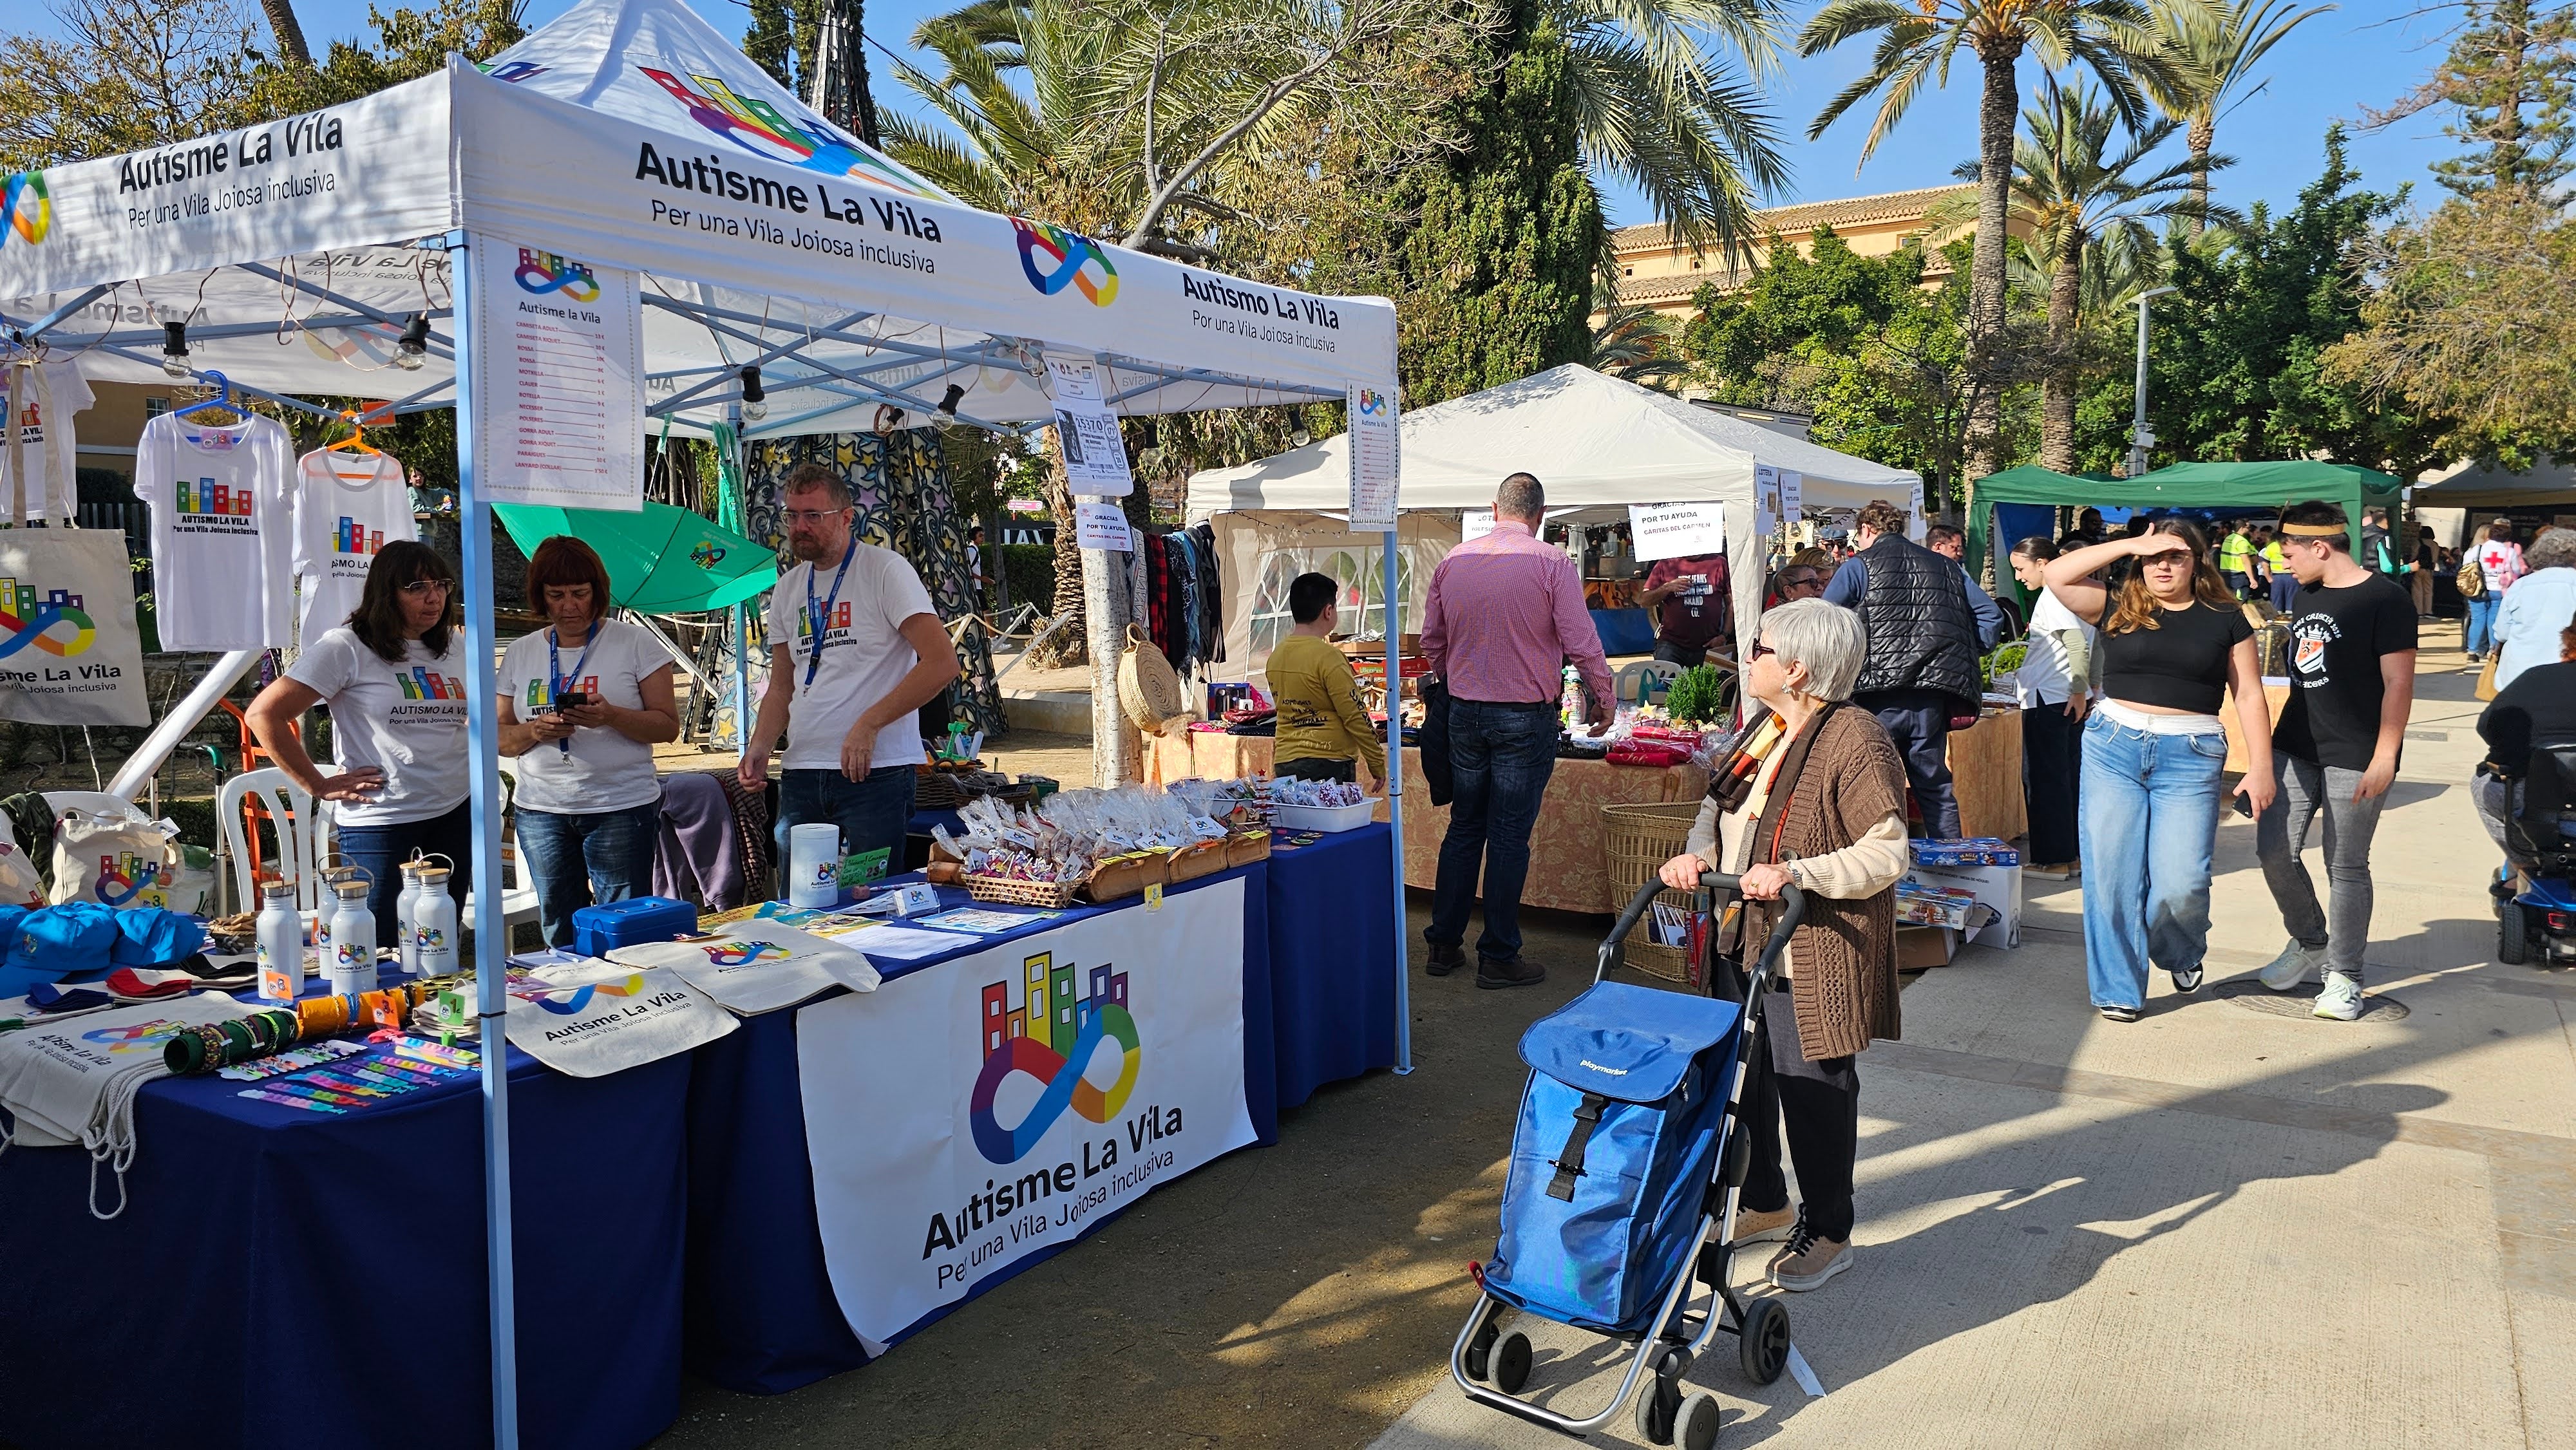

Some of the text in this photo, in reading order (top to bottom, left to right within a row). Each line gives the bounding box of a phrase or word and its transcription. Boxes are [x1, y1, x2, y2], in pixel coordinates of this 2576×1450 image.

[120, 112, 343, 194] Autisme La Vila
[129, 169, 334, 229] Per una Vila Joiosa inclusiva
[636, 142, 942, 243] Autisme La Vila
[652, 200, 934, 274] Per una Vila Joiosa inclusiva
[1182, 272, 1340, 330] Autismo La Vila
[519, 301, 601, 323] Autisme la Vila
[516, 321, 542, 330] CAMISETA
[1193, 310, 1335, 353] Por una Vila Joiosa inclusiva
[516, 333, 542, 341] CAMISETA
[519, 368, 544, 377] MOTXILLA
[1075, 417, 1103, 431] 25370
[1361, 419, 1376, 428] Autisme
[182, 516, 249, 525] AUTISMO LA VILA
[1671, 511, 1698, 520] AYUDA
[358, 560, 369, 569] LA
[1683, 596, 1703, 605] BRAND
[834, 629, 849, 639] VILA
[44, 663, 122, 682] La Vila
[29, 683, 117, 693] Joiosa inclusiva
[390, 706, 440, 715] AUTISMO
[544, 990, 687, 1042] Autisme La Vila
[580, 1030, 600, 1040] una
[600, 1025, 620, 1035] Vila
[621, 1015, 652, 1028] Joiosa
[650, 1001, 692, 1018] inclusiva
[1580, 1059, 1628, 1075] playmarket
[922, 1105, 1182, 1261] Autisme La Vila
[938, 1150, 1173, 1290] Per una Vila Joiosa inclusiva
